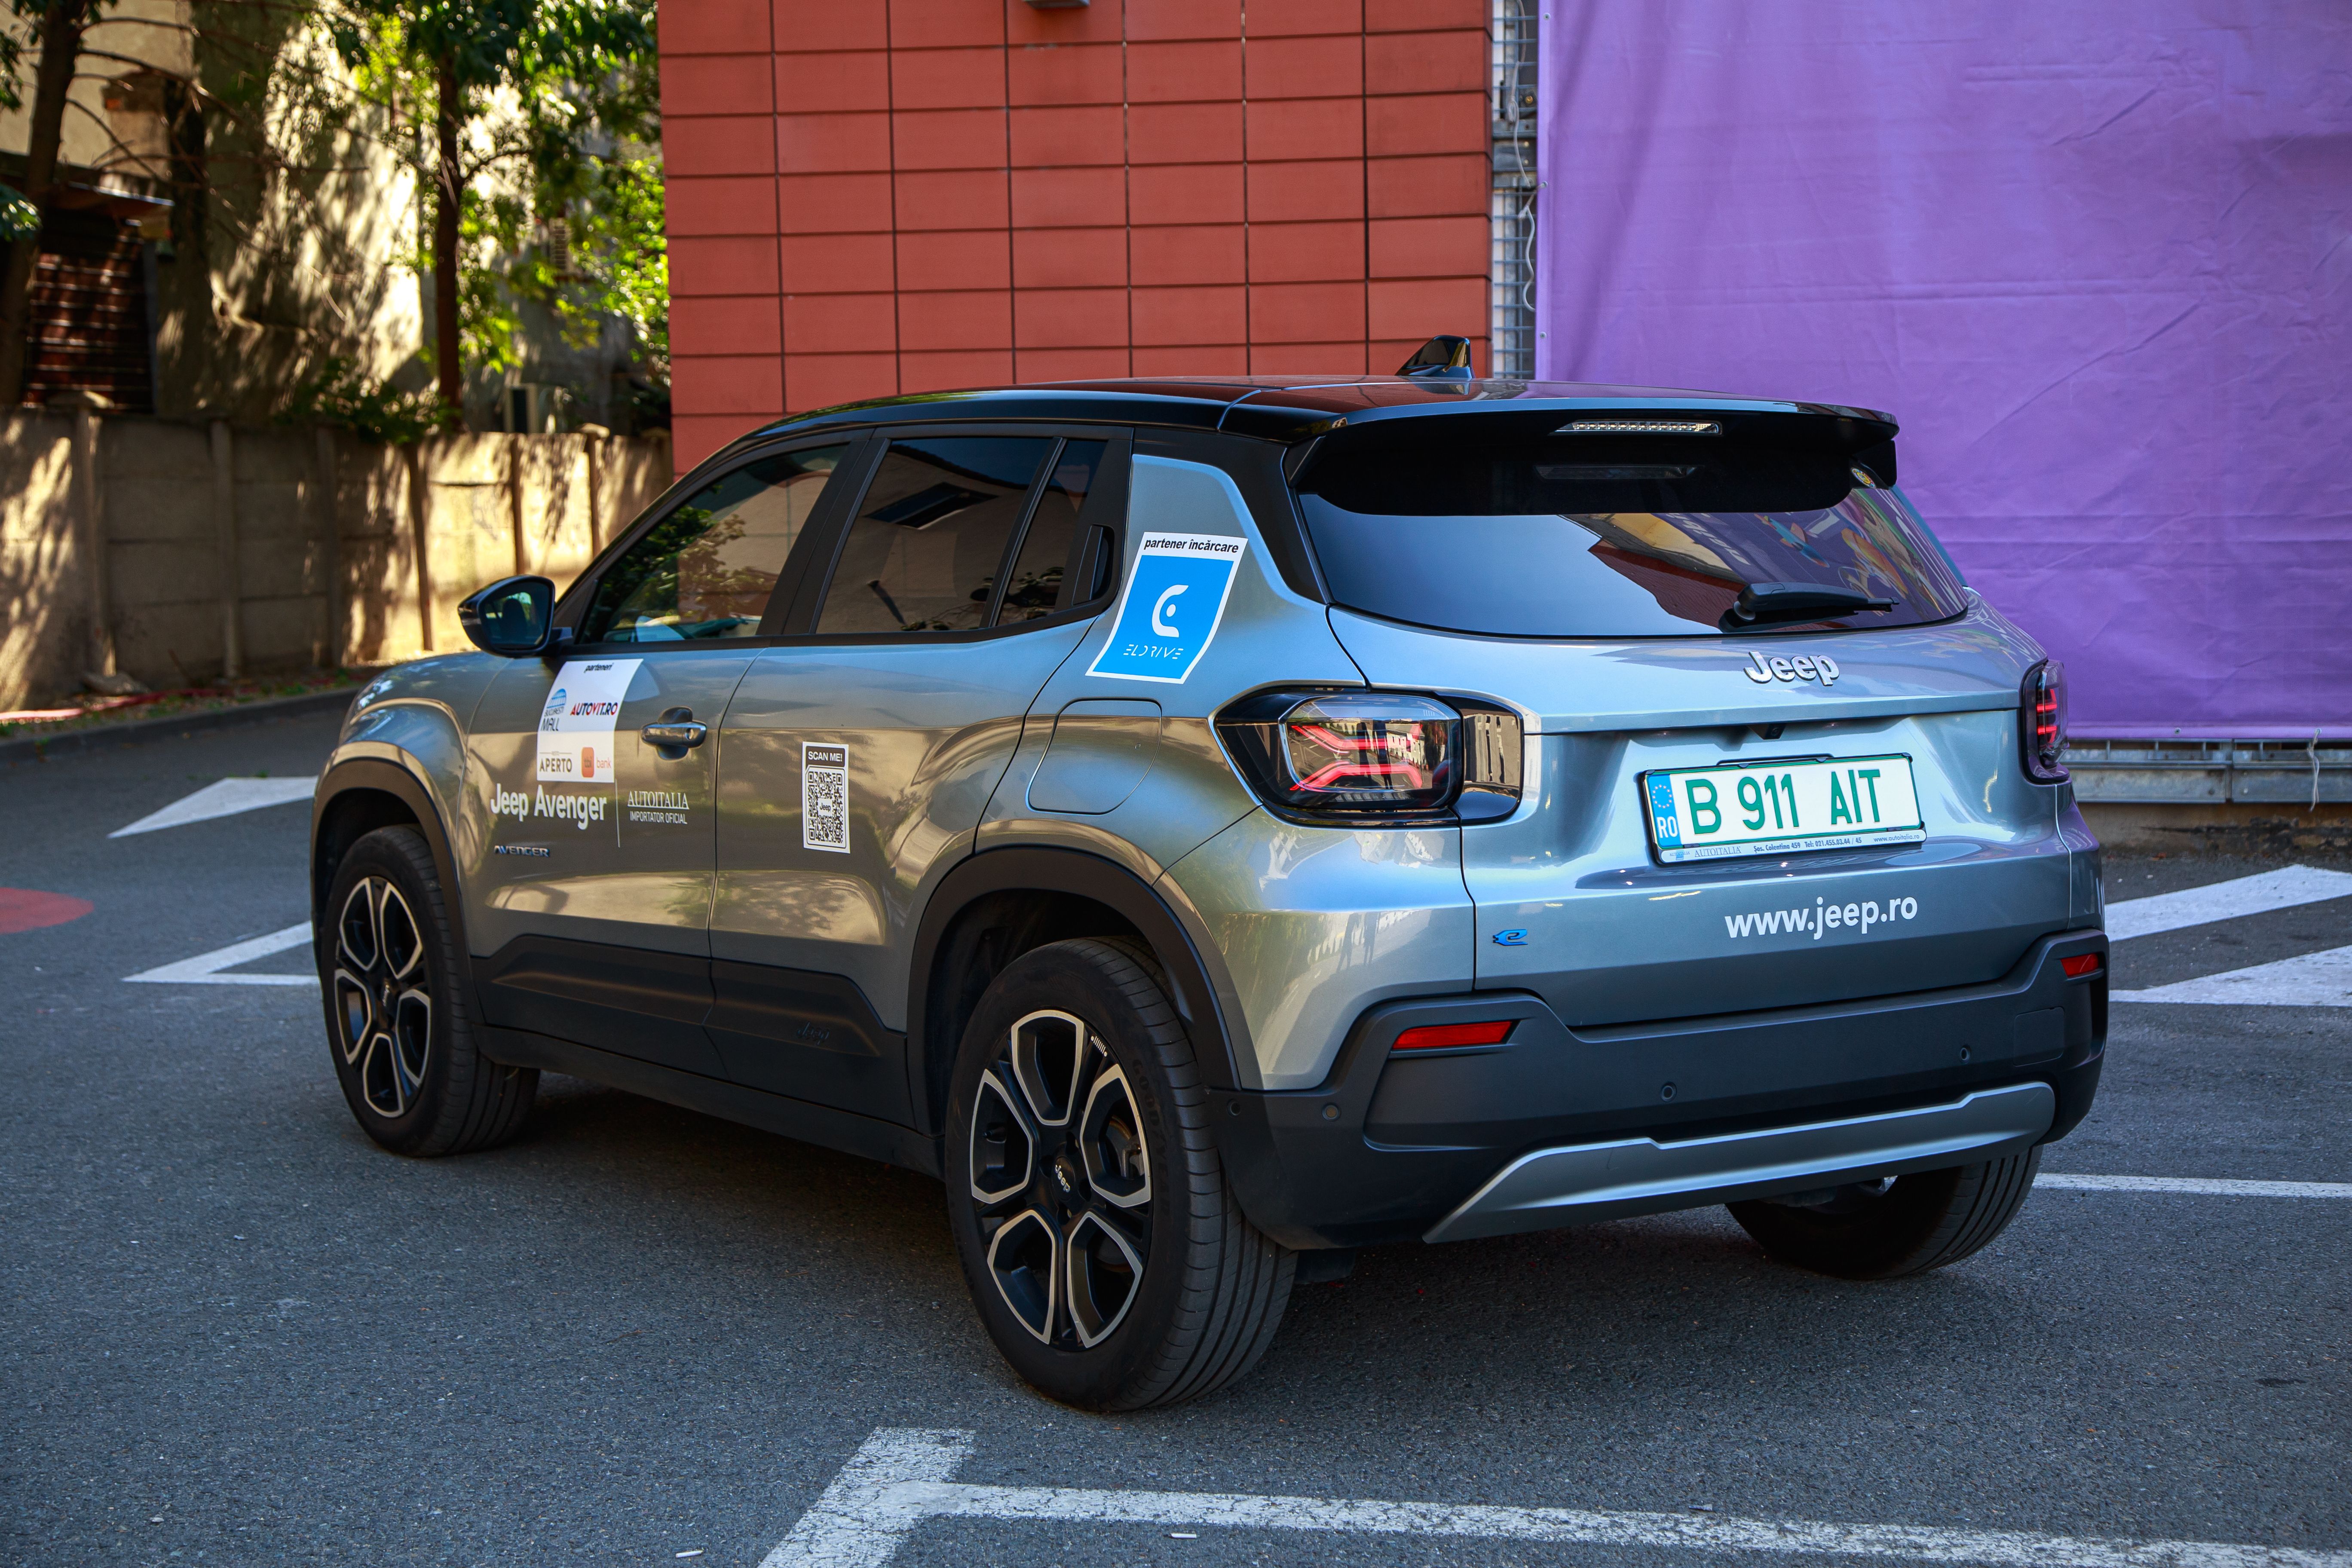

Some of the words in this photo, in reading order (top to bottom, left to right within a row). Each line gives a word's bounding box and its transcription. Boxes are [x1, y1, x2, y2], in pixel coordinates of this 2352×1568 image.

[1143, 539, 1187, 550] partener
[1188, 539, 1239, 553] încărcare
[1123, 643, 1184, 659] ELDRIVE
[584, 663, 614, 673] parteneri
[1743, 650, 1840, 686] Jeep
[570, 702, 618, 716] AUTOVIT.RO
[541, 717, 559, 731] MALL
[596, 757, 612, 769] bank
[808, 751, 828, 761] SCAN
[830, 753, 843, 763] ME!
[539, 758, 573, 772] APERTO
[490, 783, 529, 822] Jeep
[534, 784, 607, 830] Avenger
[628, 790, 689, 809] AUTOITALIA
[1685, 778, 1721, 835] B
[1737, 774, 1800, 830] 911
[1831, 769, 1881, 825] AIT
[820, 802, 831, 812] Jeep
[630, 811, 665, 823] IMPORTATOR
[665, 813, 688, 824] OFICIAL
[1657, 815, 1678, 839] RO
[1815, 838, 1850, 847] 021.455.03.44
[1873, 834, 1920, 843] www.autoitalia.ro
[494, 845, 550, 858] AVENGER
[1695, 846, 1742, 858] AUTOITALIA
[1724, 896, 1918, 940] www.jeep.ro
[1055, 1164, 1070, 1193] Jeep
